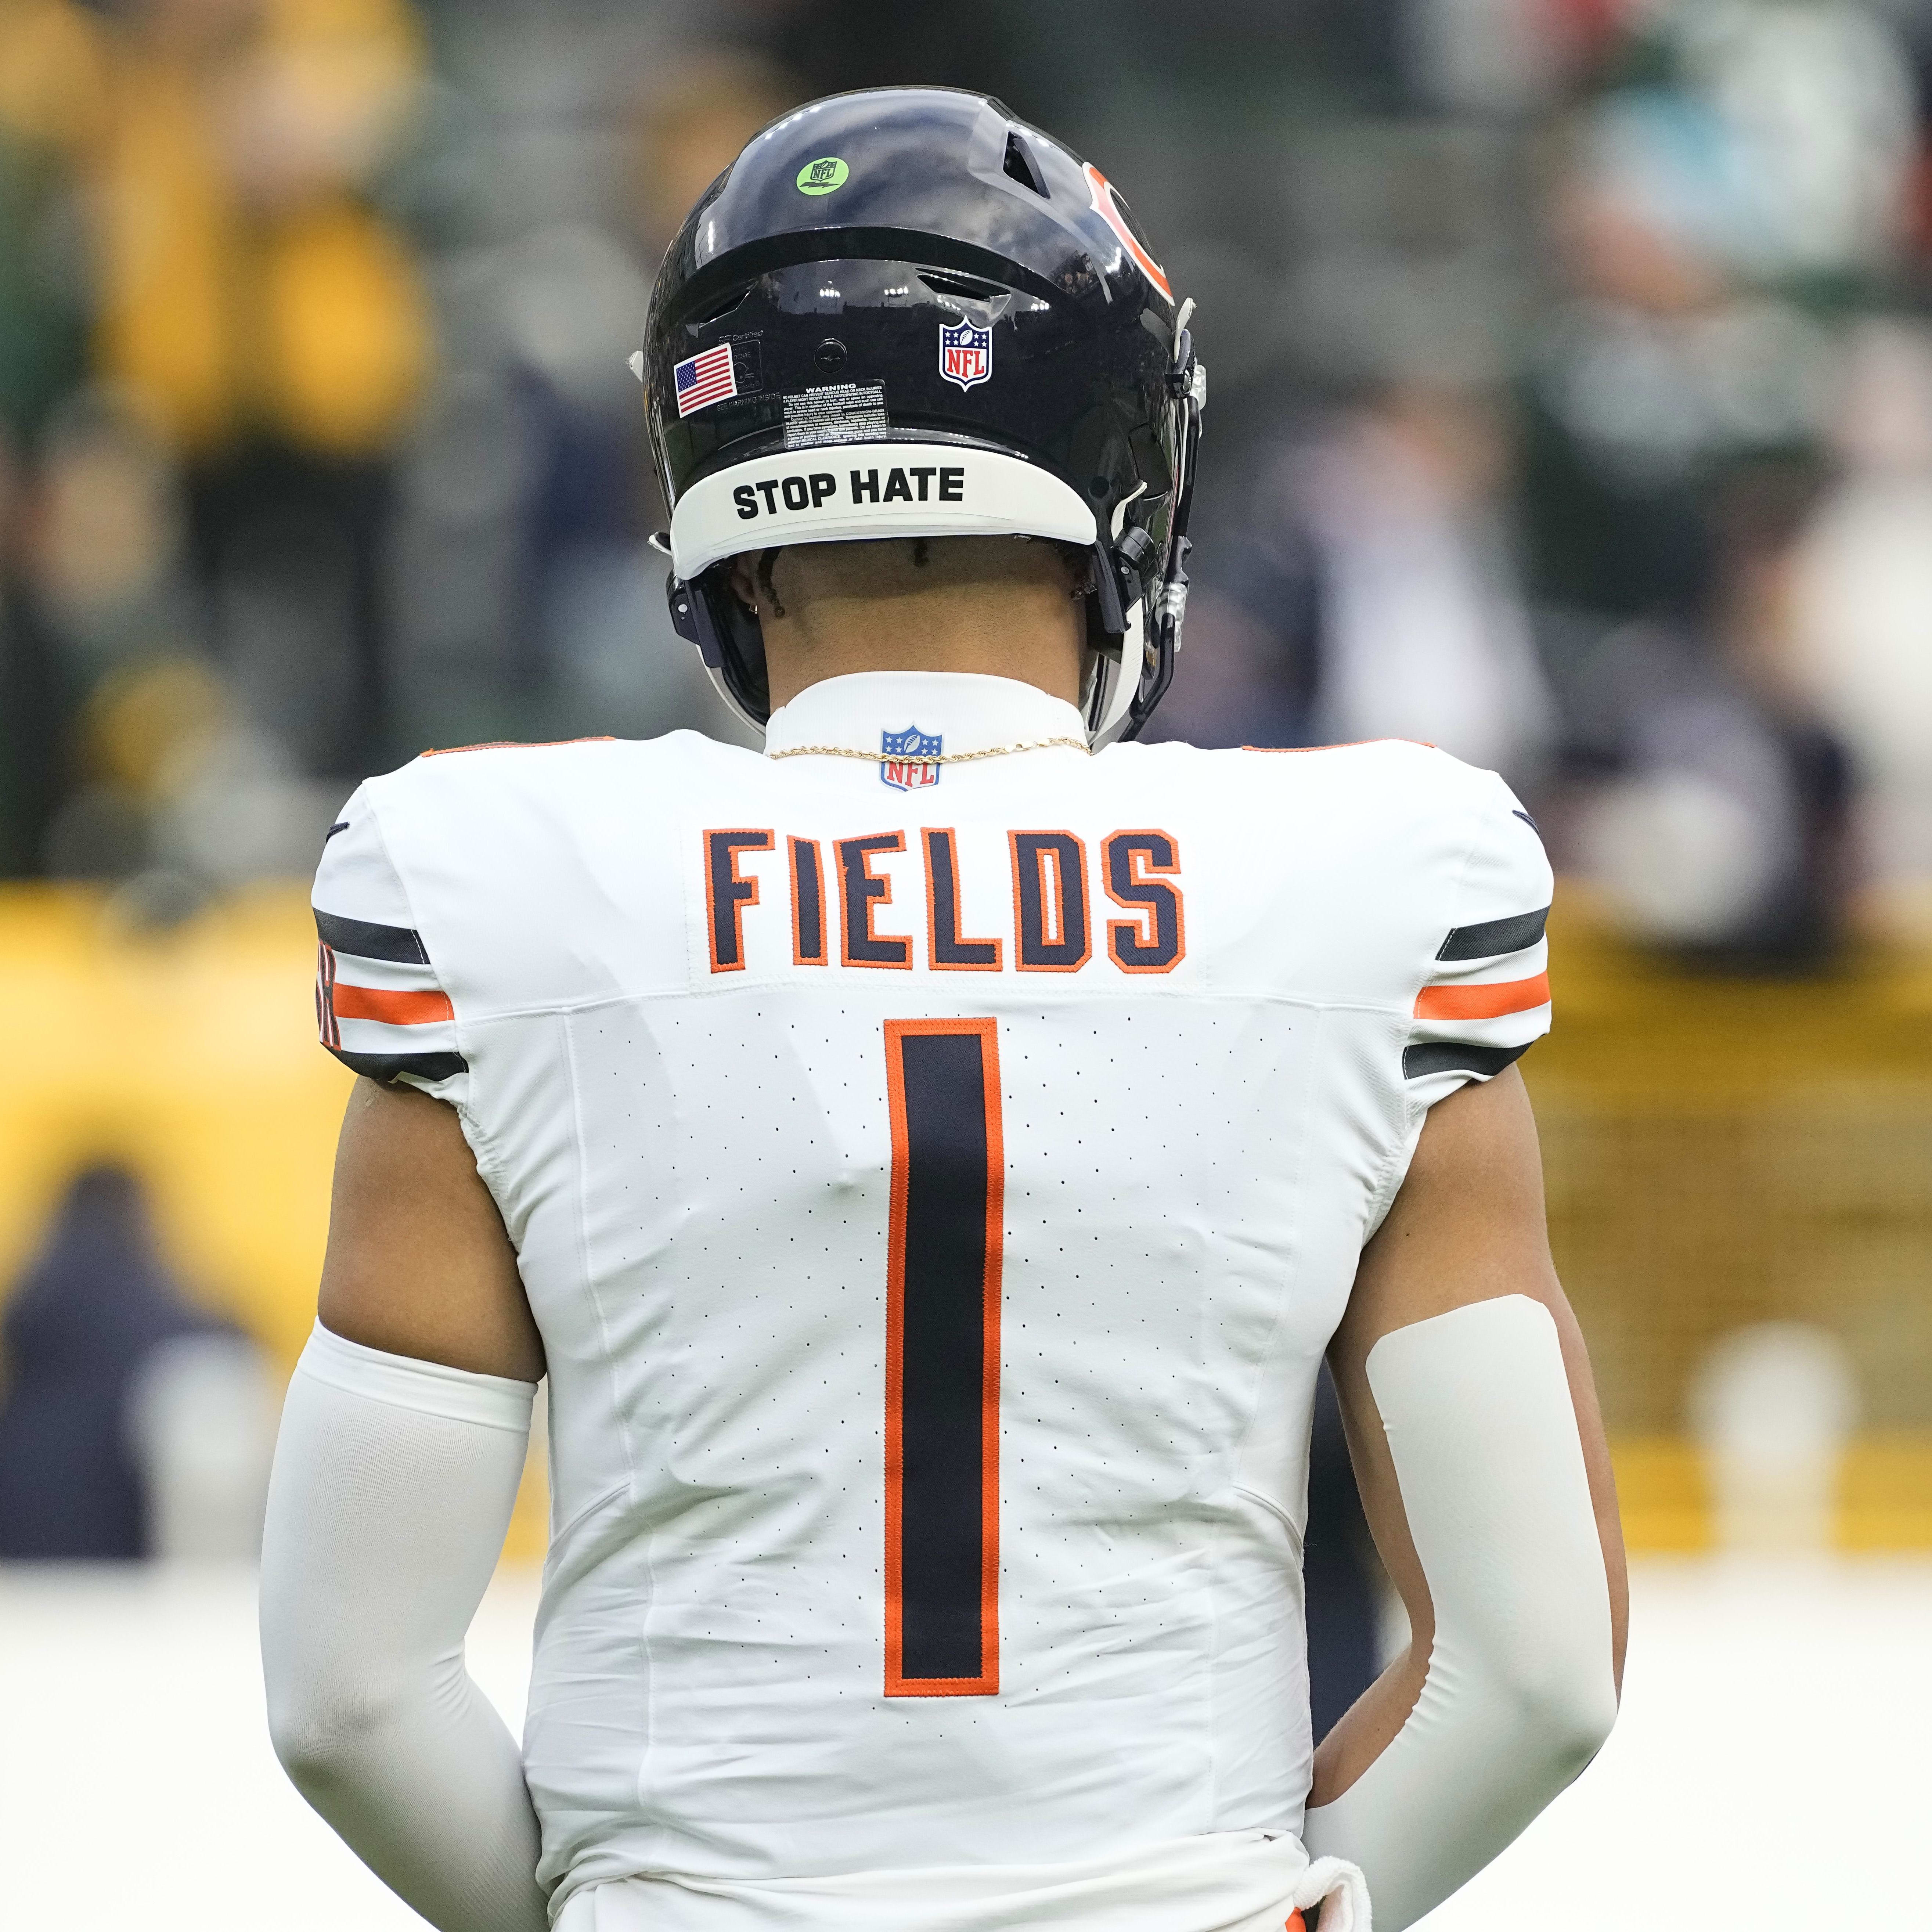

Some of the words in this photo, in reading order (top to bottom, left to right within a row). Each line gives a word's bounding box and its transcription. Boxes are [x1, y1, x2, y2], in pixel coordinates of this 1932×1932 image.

[812, 169, 832, 179] NFL
[732, 352, 751, 361] OCSAE
[947, 349, 984, 378] NFL
[805, 383, 856, 393] WARNING
[717, 403, 728, 411] SEE
[729, 397, 757, 407] WARNING
[759, 392, 780, 401] INSIDE
[733, 473, 836, 520] STOP
[850, 467, 965, 504] HATE
[887, 761, 934, 787] NFL
[702, 826, 1187, 974] FIELDS
[883, 1016, 1004, 1697] 1
